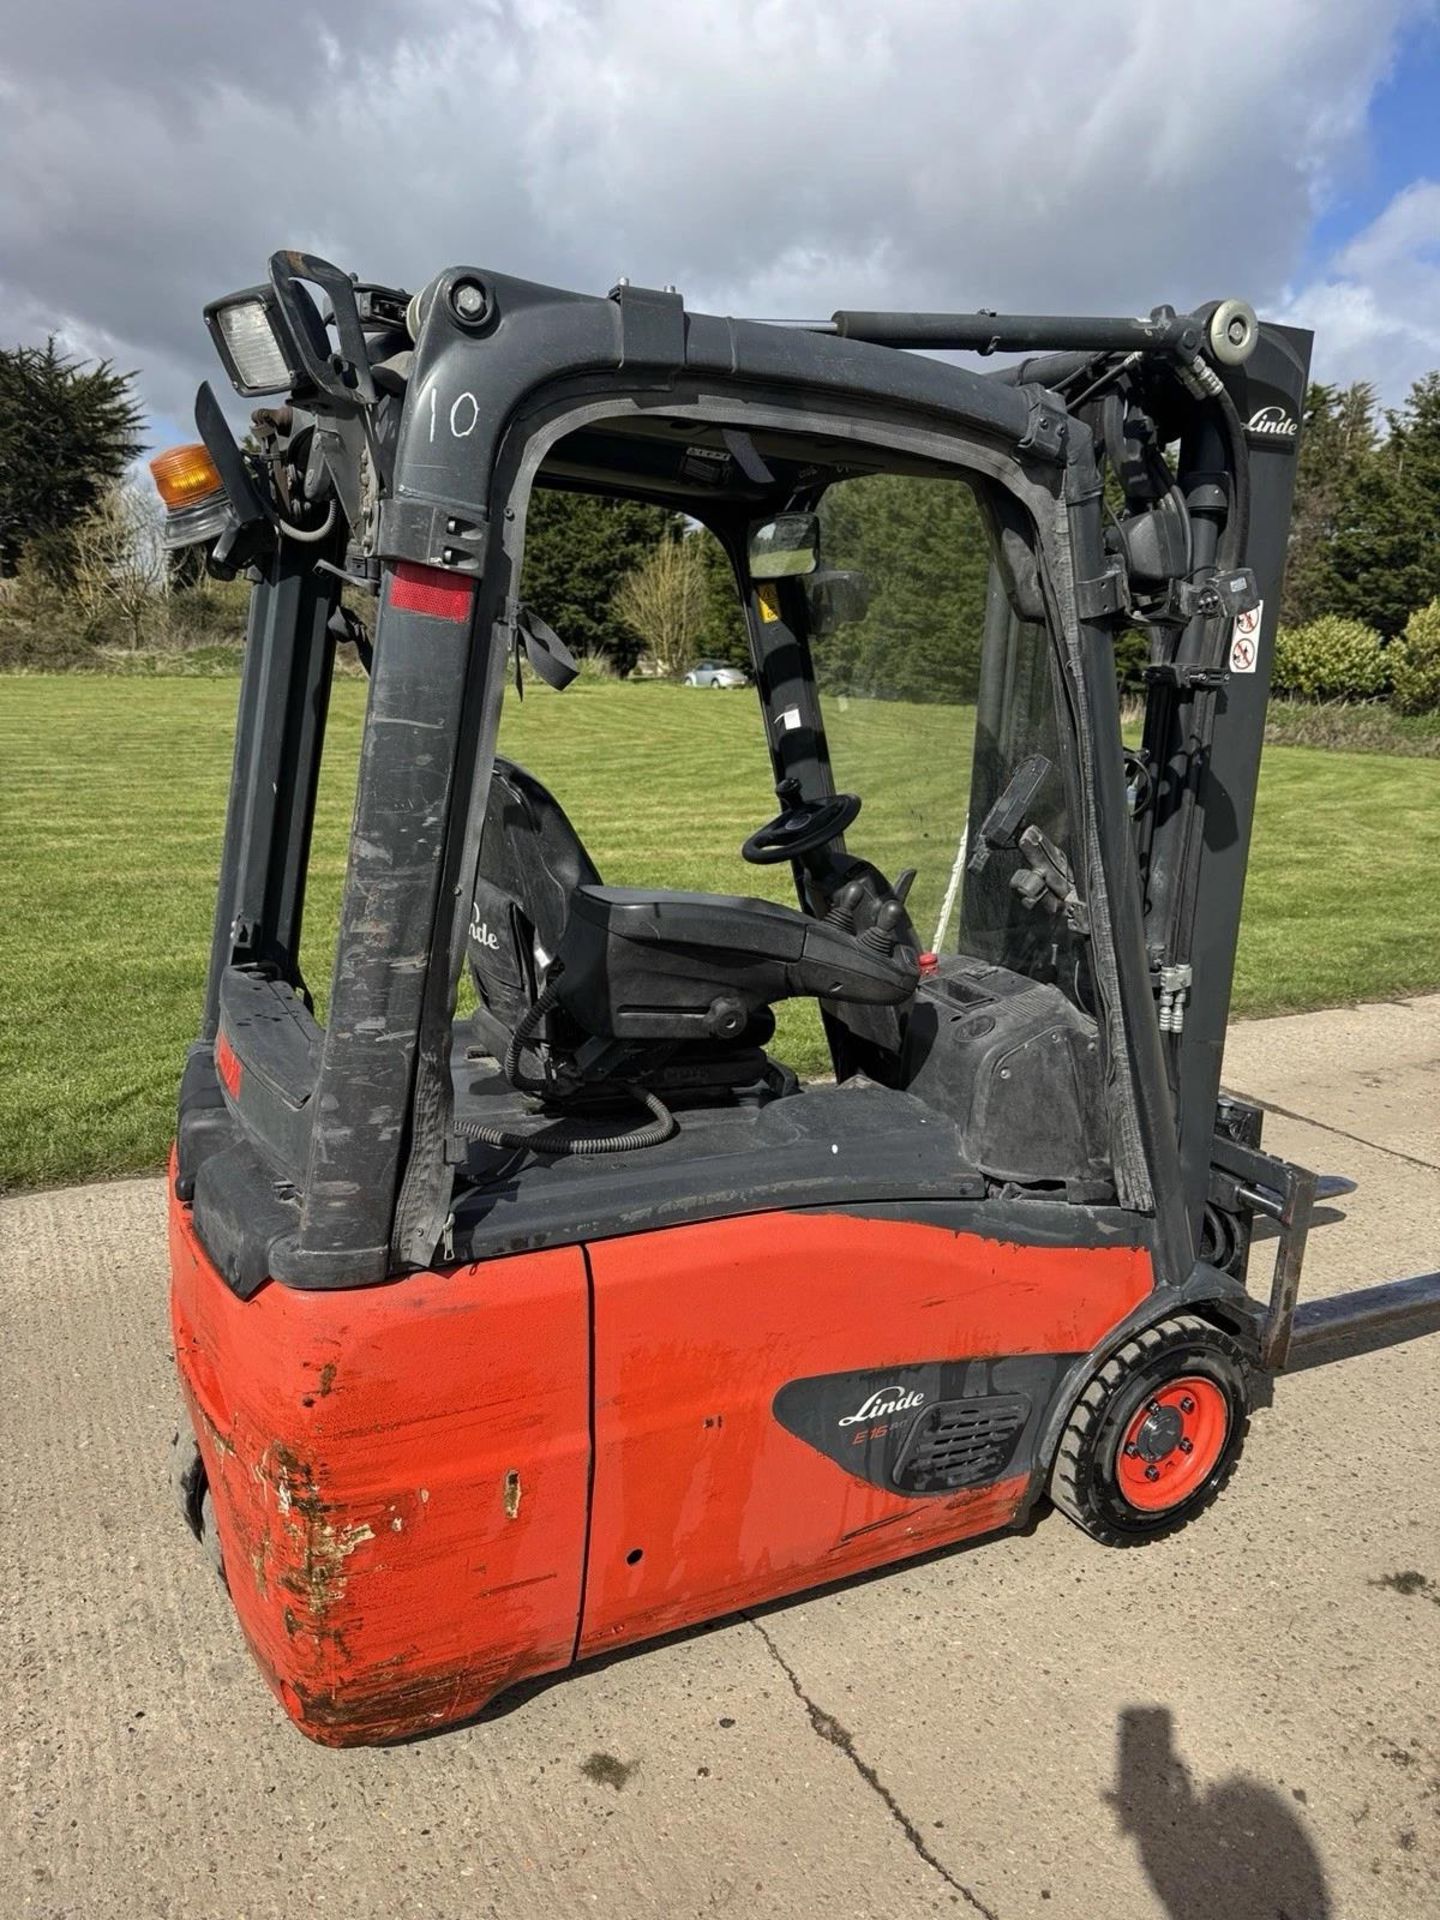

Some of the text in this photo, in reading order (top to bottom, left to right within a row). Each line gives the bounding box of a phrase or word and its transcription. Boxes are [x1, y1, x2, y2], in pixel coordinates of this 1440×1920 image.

[429, 387, 480, 443] 10
[1240, 406, 1298, 436] Linde
[468, 901, 500, 950] nde
[838, 1385, 924, 1427] Linde
